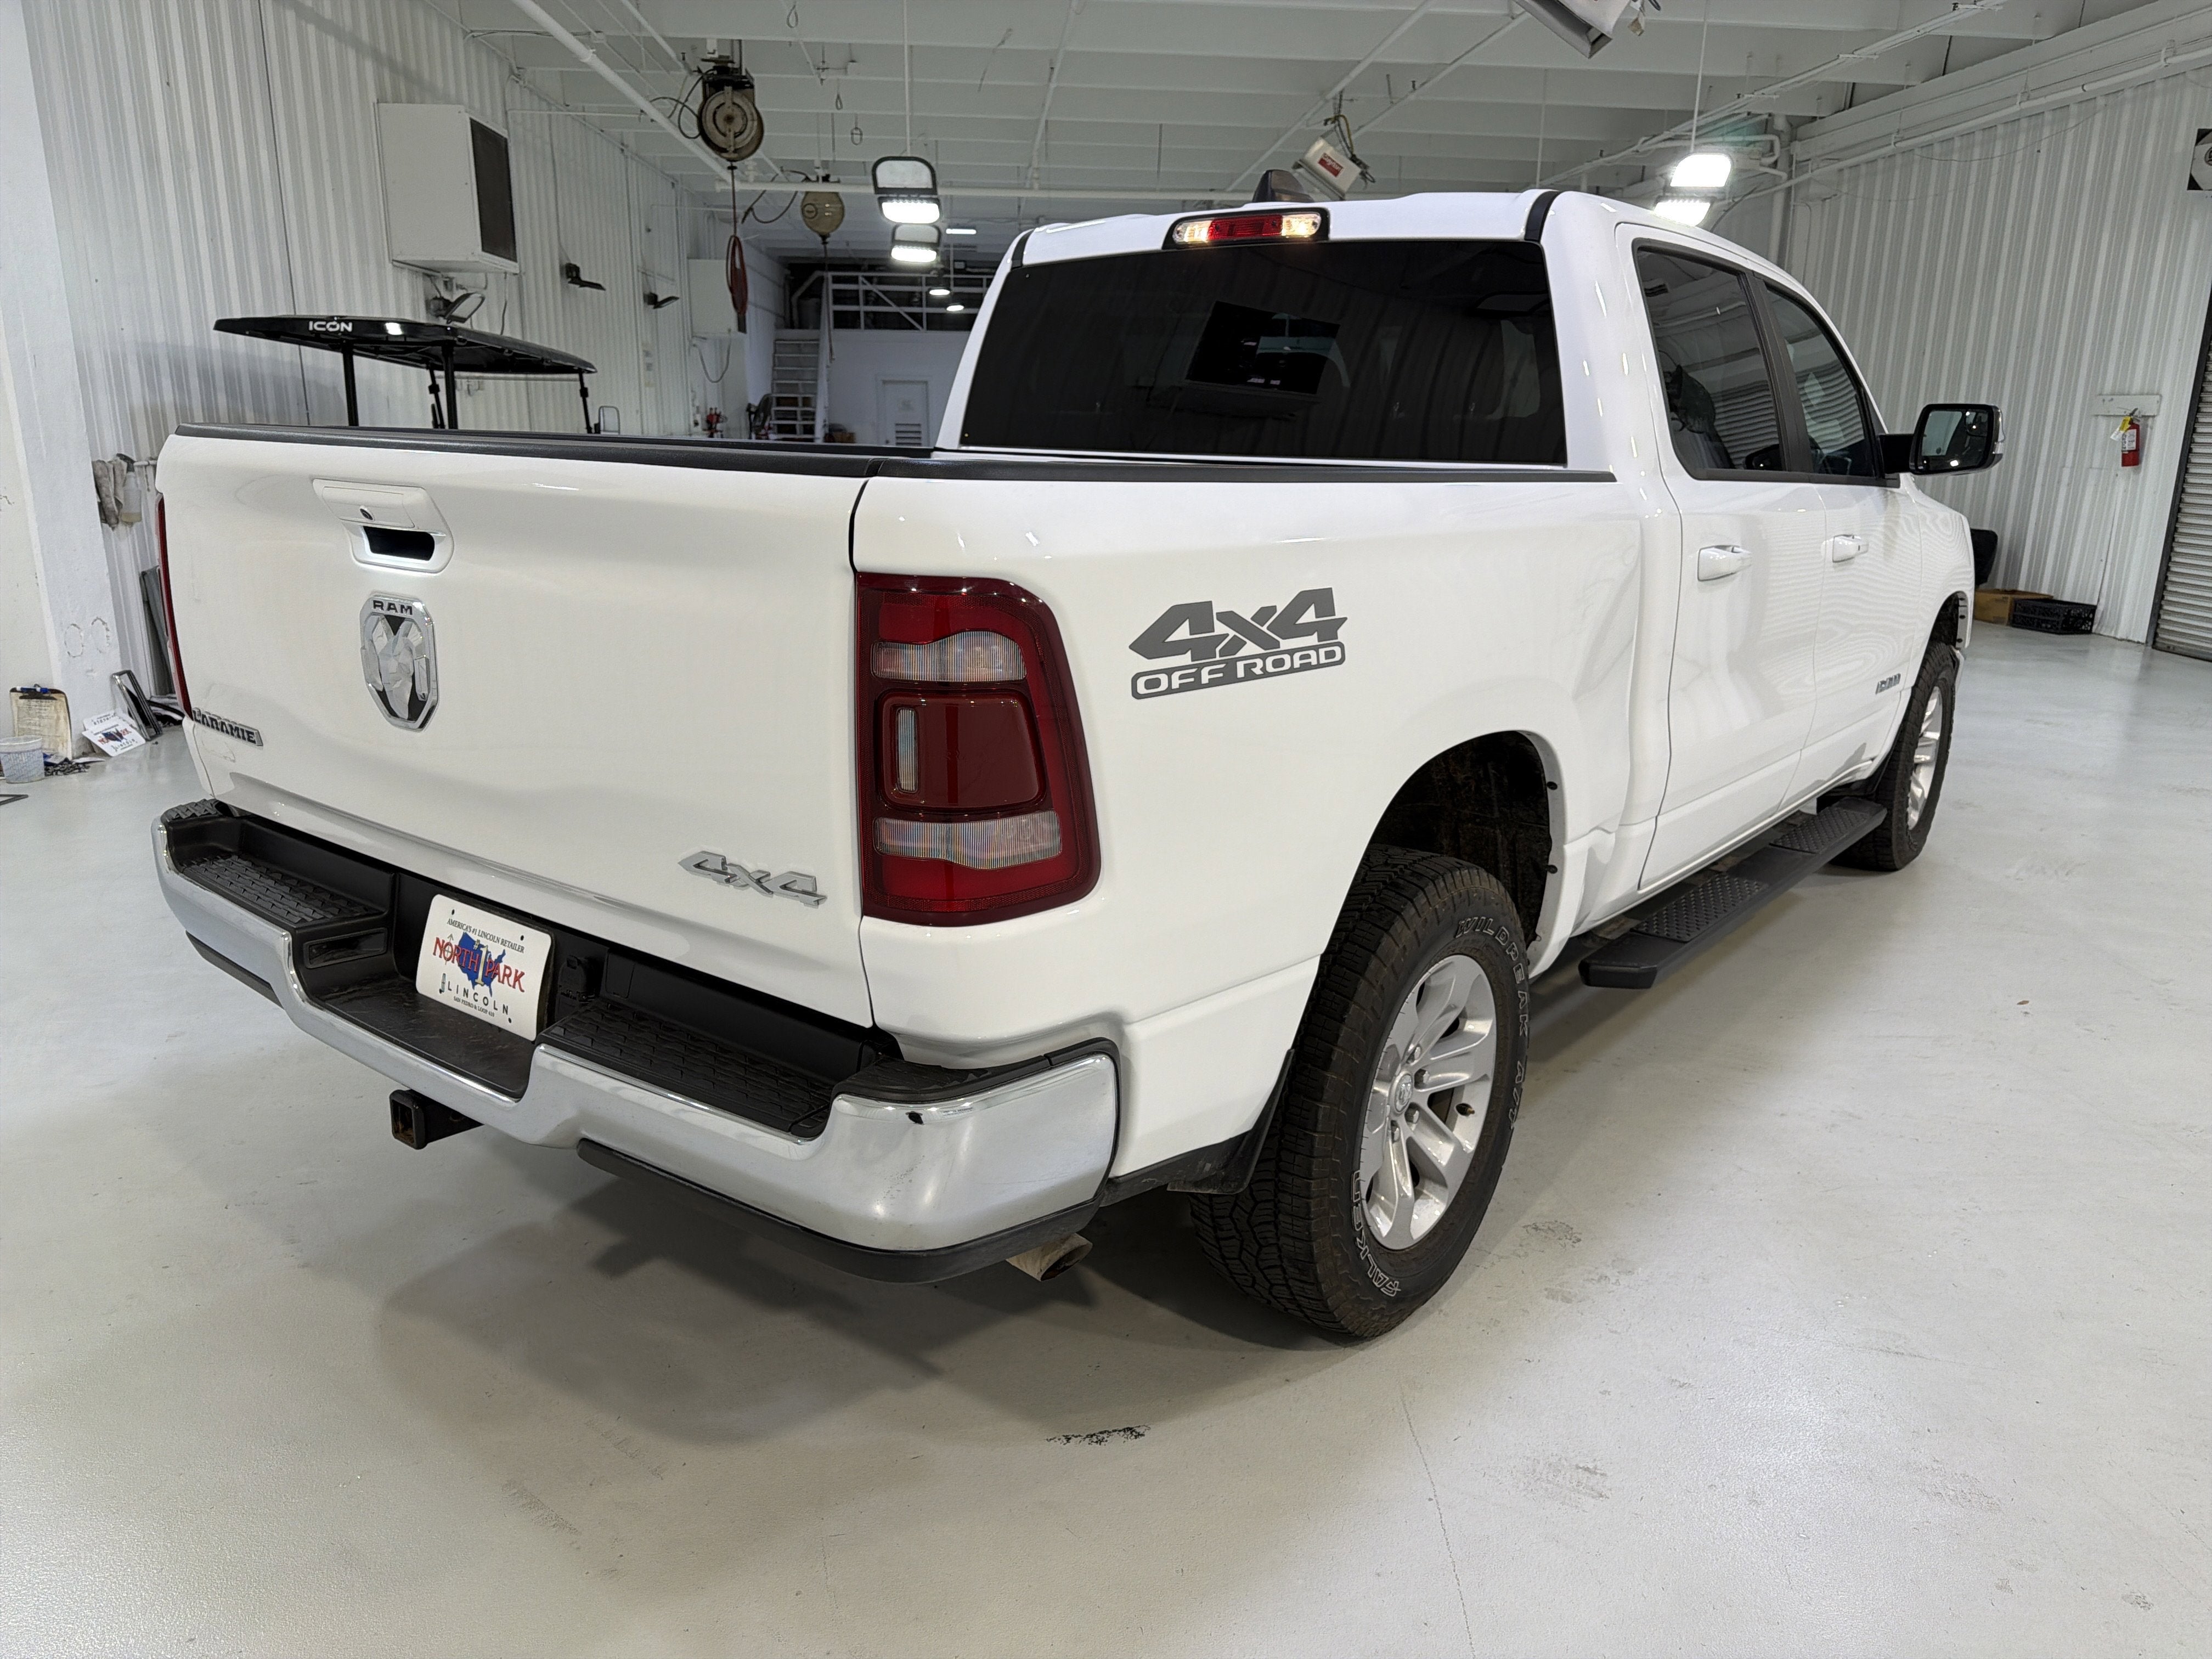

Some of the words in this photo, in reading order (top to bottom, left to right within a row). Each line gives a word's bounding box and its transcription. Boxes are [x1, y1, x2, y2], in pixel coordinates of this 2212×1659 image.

[308, 320, 353, 332] ICON
[373, 600, 413, 616] RAM
[1136, 663, 1227, 695] OFF
[1237, 645, 1342, 678] ROAD
[192, 709, 256, 744] LARAMIE
[447, 918, 472, 933] AMERICA'S
[477, 929, 501, 944] LINCOLN
[500, 938, 525, 953] RETAILER
[432, 936, 480, 972] NORTH
[484, 957, 525, 993] PARK
[1455, 915, 1529, 1037] WILDPEAK
[448, 980, 509, 1015] LINCOLN
[461, 998, 474, 1008] PEDRO
[477, 1006, 488, 1014] LOOP
[1351, 1170, 1402, 1297] FALKEN
